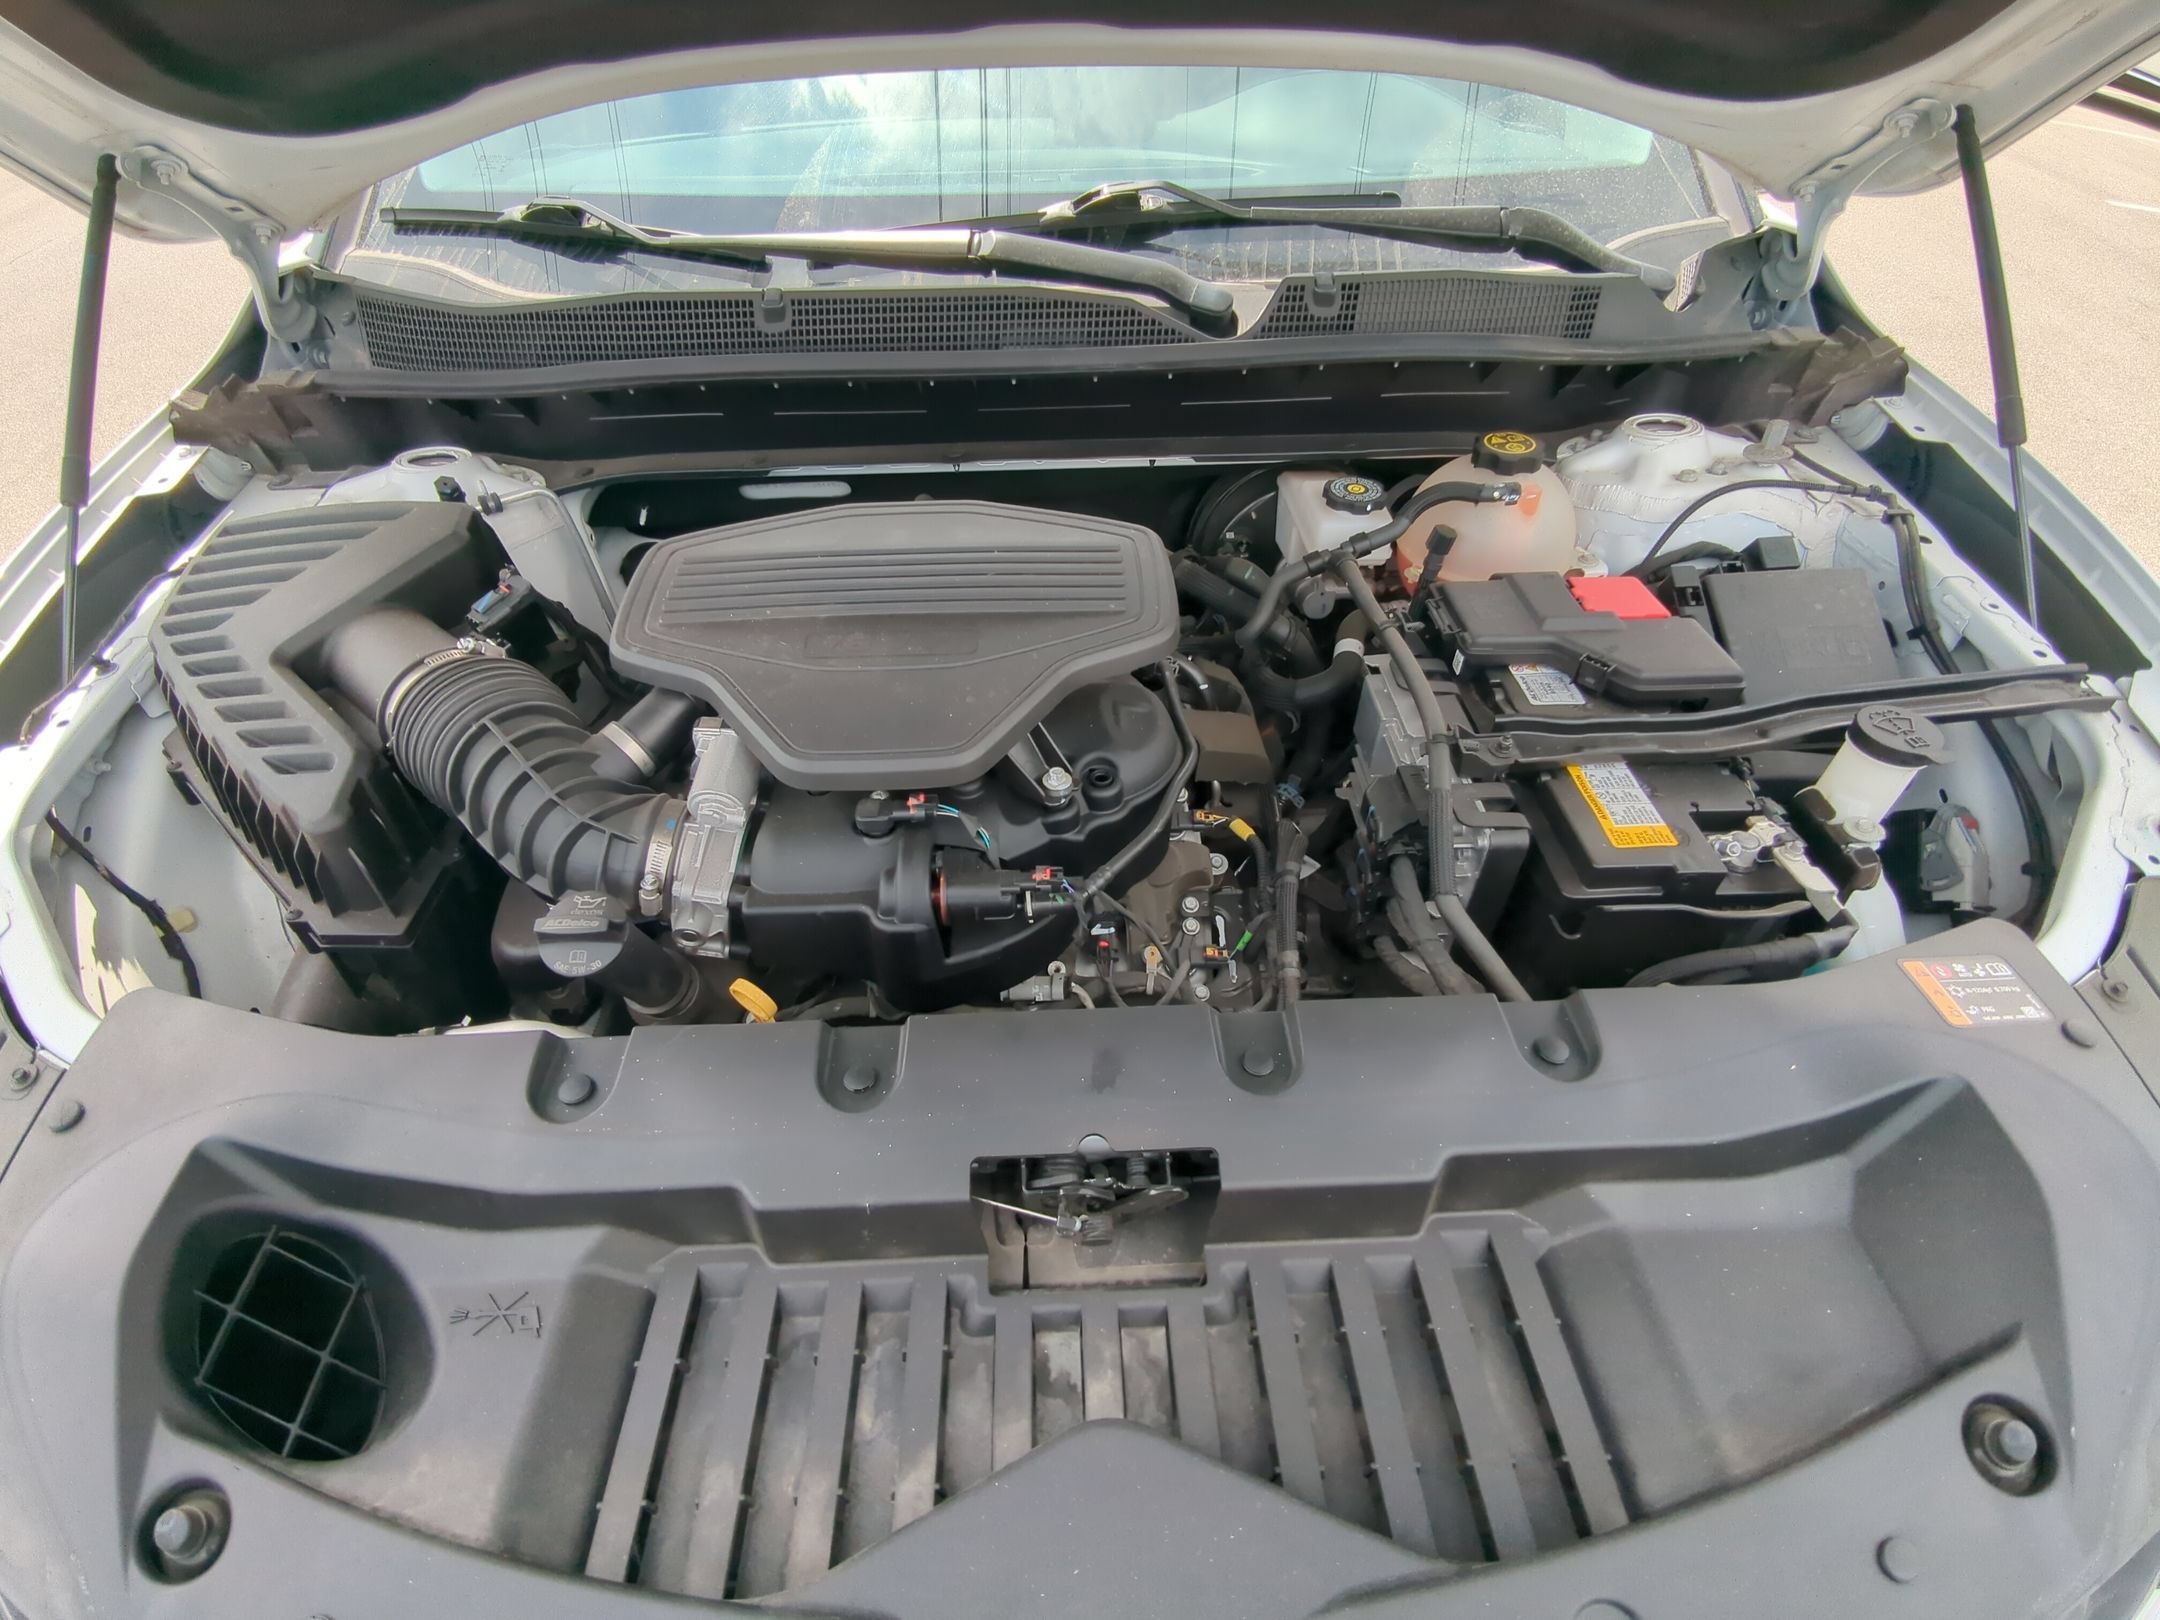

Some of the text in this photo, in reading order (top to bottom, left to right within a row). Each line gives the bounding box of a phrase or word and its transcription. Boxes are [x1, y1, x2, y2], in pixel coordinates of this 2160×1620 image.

[544, 919, 600, 927] ACDelco
[553, 960, 602, 975] SAE 5W-30
